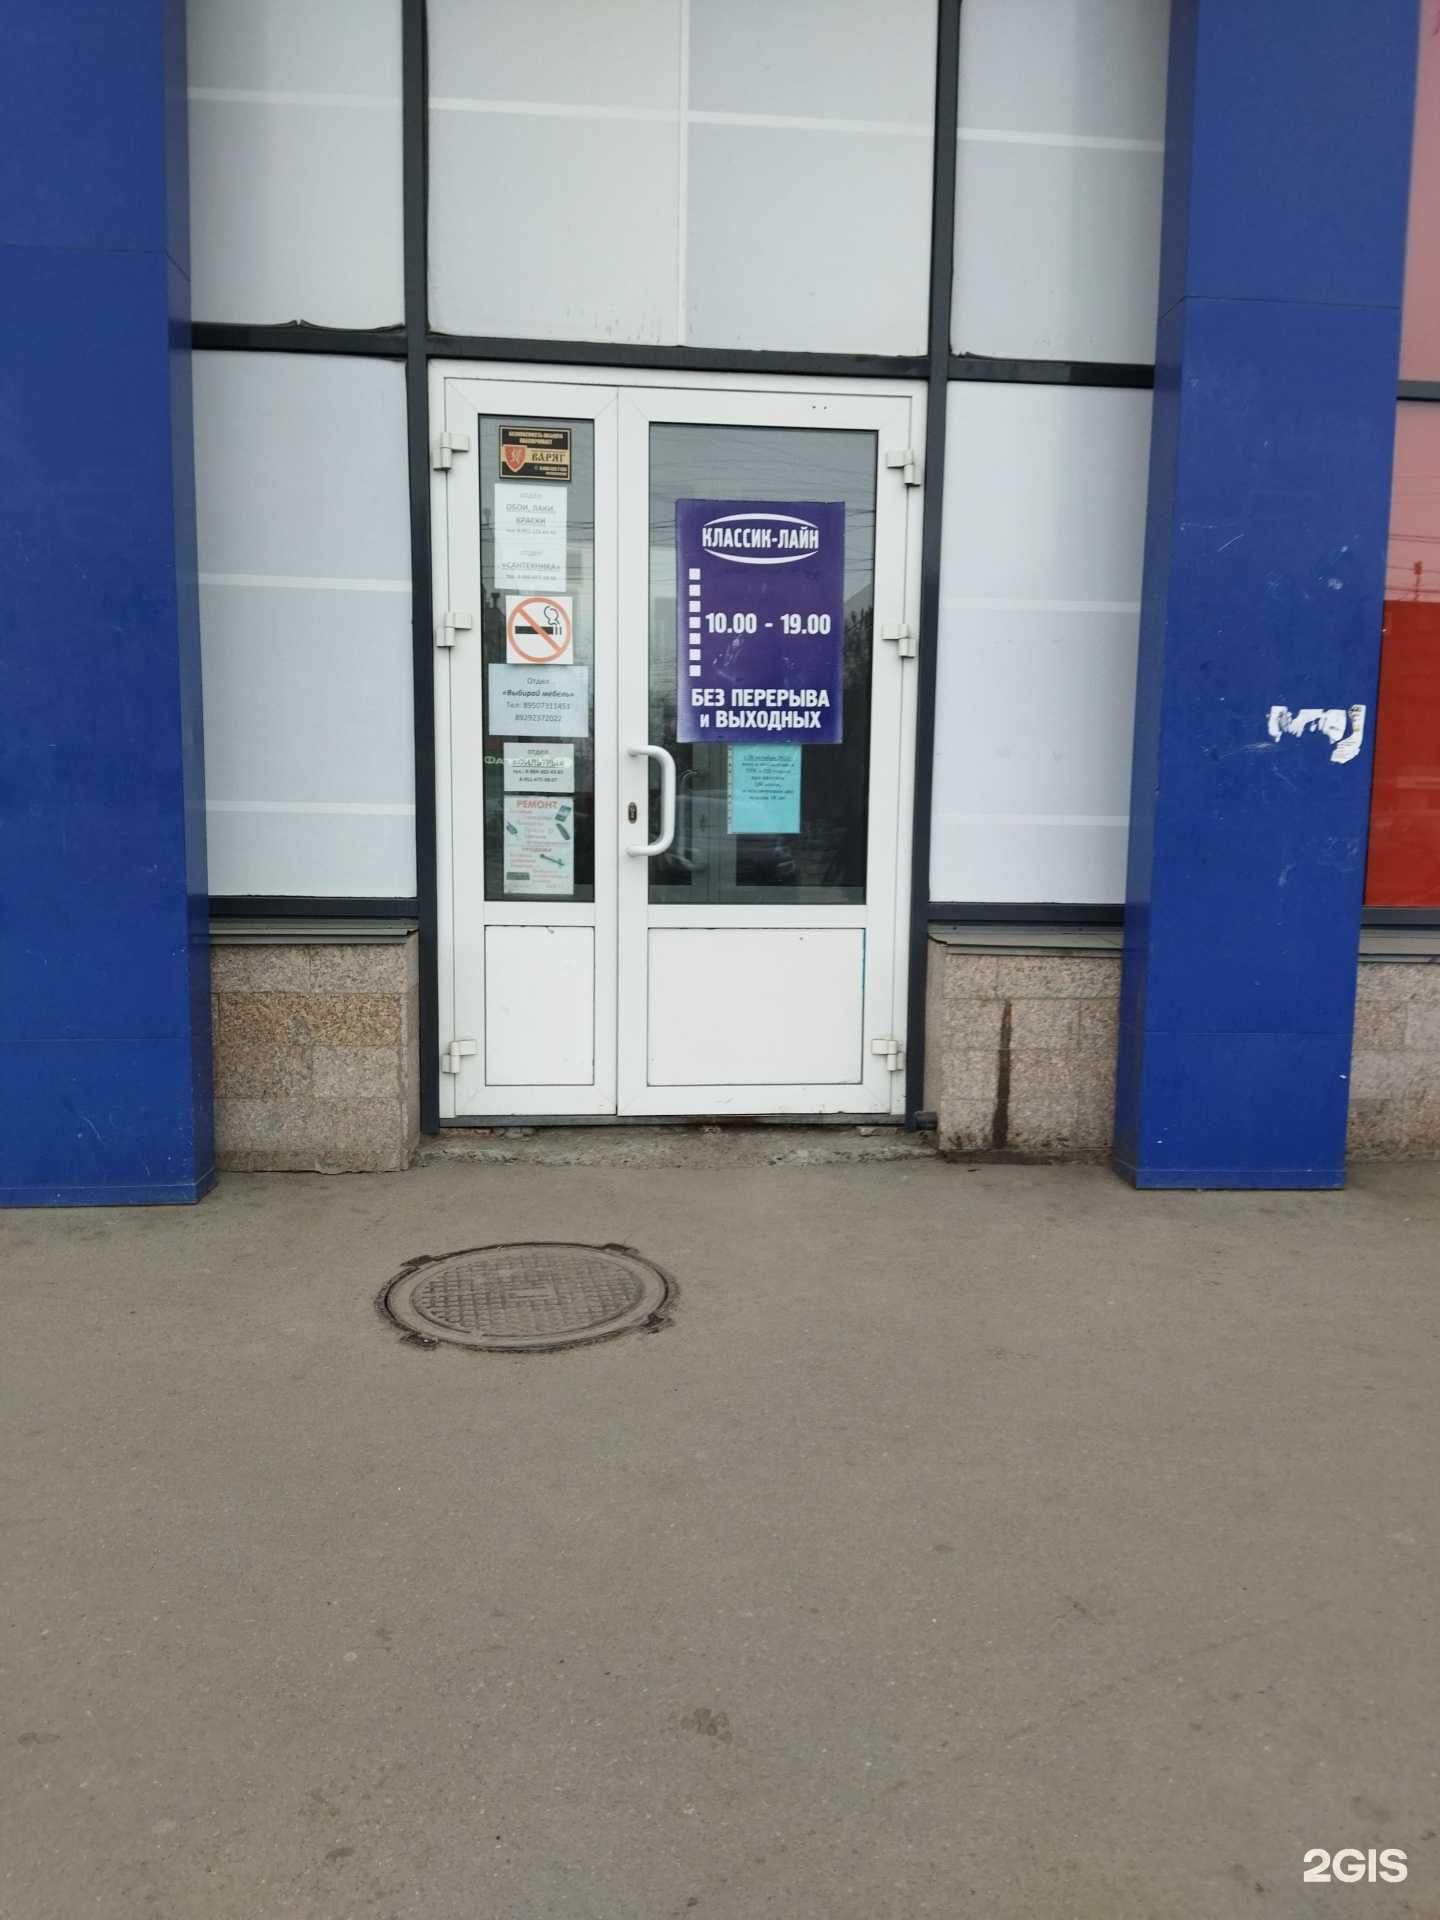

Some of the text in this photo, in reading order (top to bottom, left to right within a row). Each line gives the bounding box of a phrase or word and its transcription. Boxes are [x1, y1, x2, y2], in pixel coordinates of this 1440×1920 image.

[702, 526, 819, 549] КЛАССИК-ЛАЙН
[705, 612, 757, 634] 10.00
[780, 613, 832, 635] 19.00
[691, 688, 830, 708] БЕЗ ПЕРЕРЫВА
[716, 710, 821, 731] ВЫХОДНЫХ
